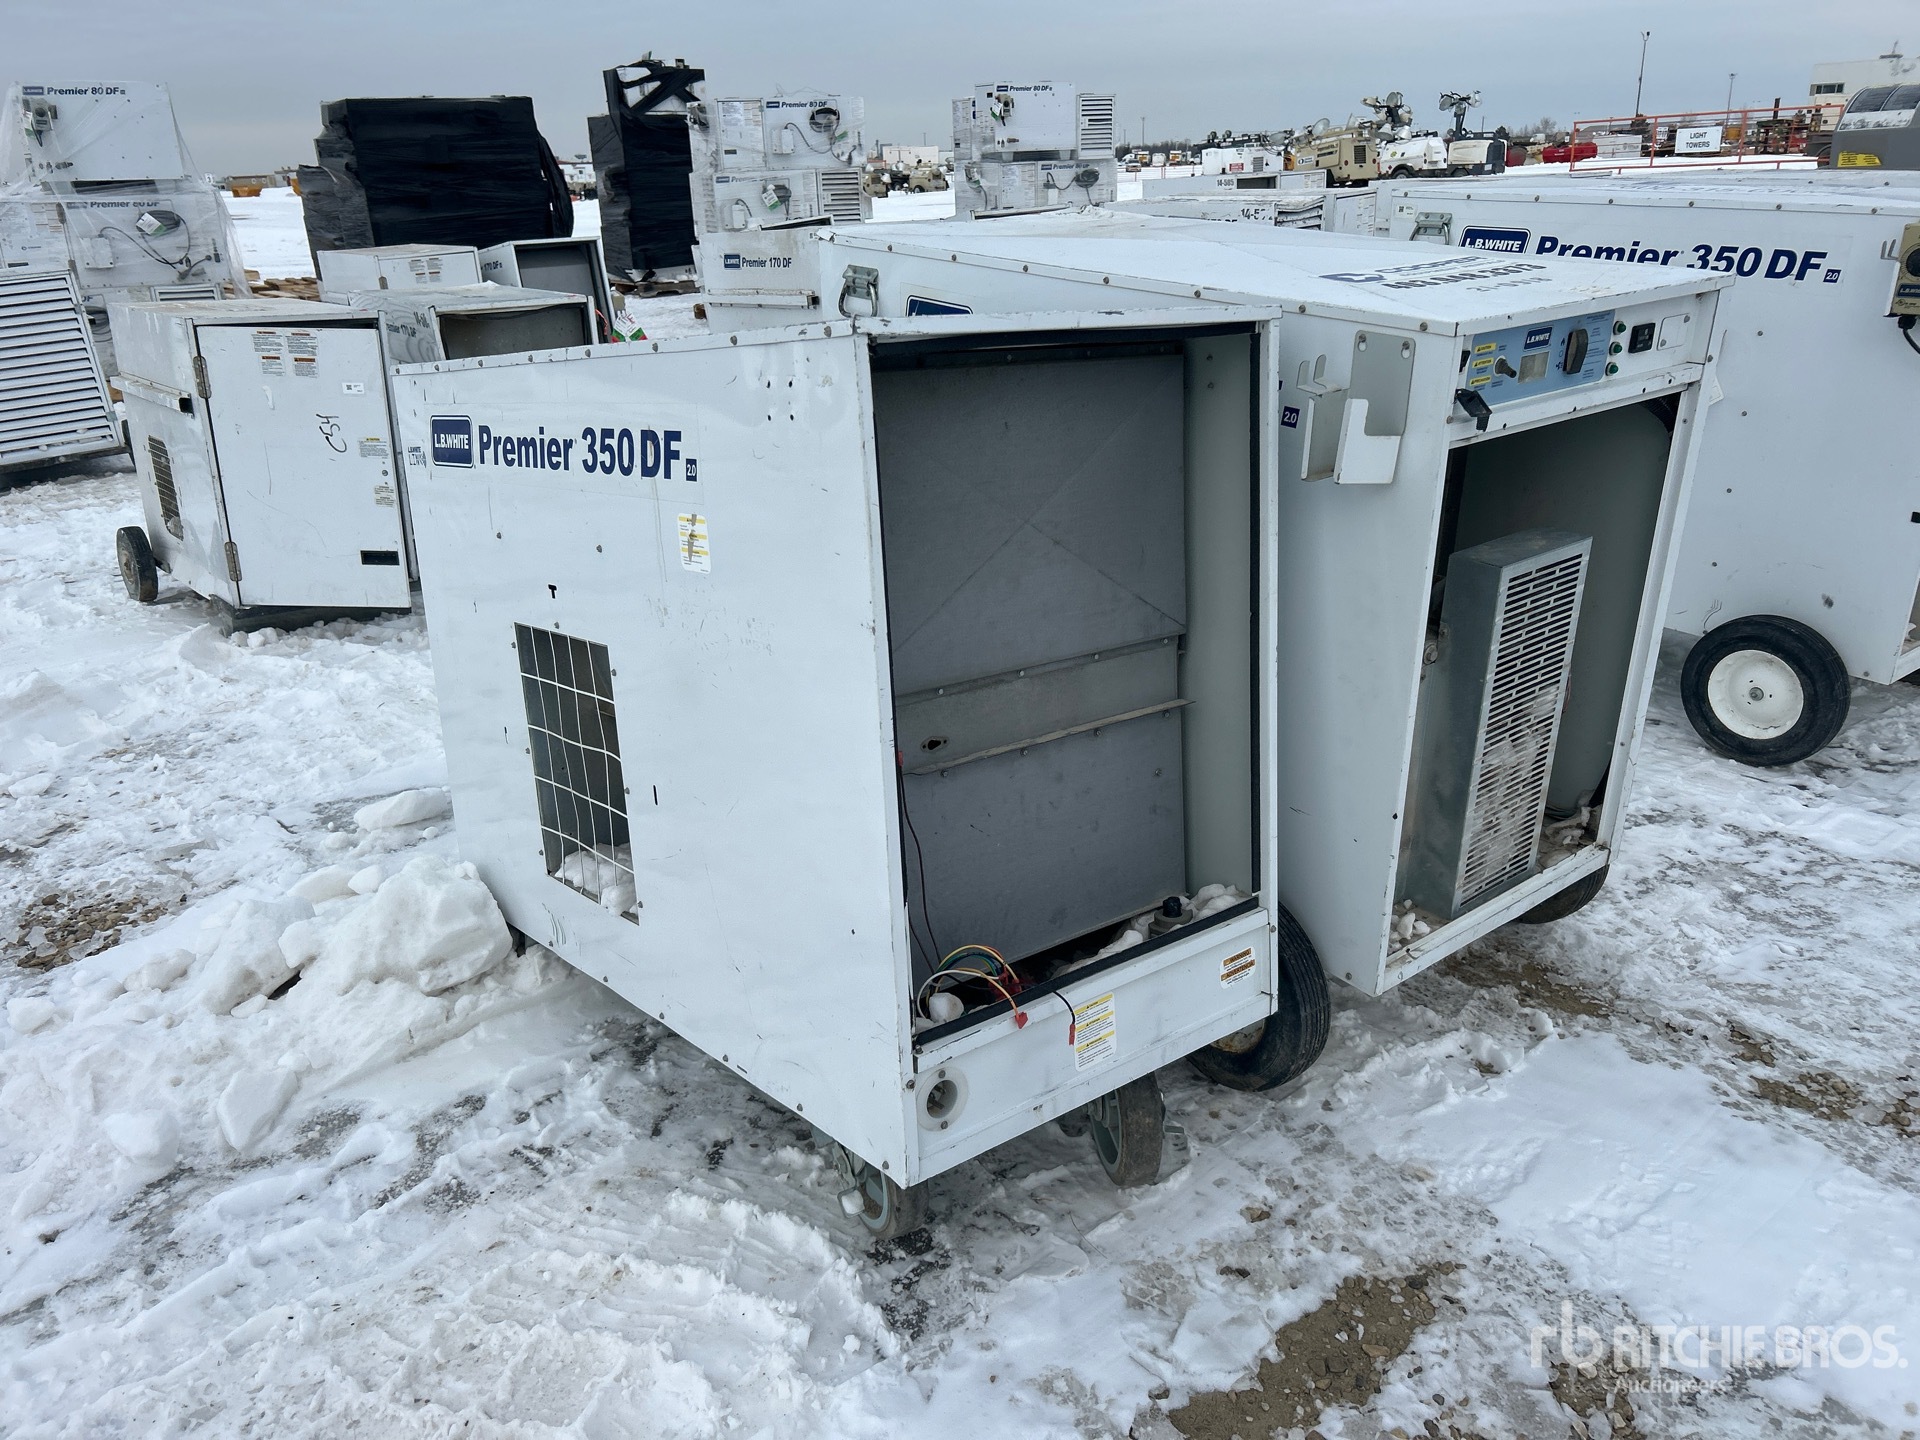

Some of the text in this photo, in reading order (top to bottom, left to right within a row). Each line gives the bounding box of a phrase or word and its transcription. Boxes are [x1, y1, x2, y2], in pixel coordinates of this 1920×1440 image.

[47, 87, 88, 95] Premier
[91, 87, 104, 95] 80
[105, 87, 119, 95] DF
[1690, 131, 1707, 139] LIGHT
[1686, 141, 1710, 149] TOWERS
[1465, 238, 1522, 251] L.B.WHITE
[741, 257, 767, 268] Premier
[769, 257, 782, 268] 170
[782, 257, 792, 268] DF
[1536, 235, 1839, 281] Premier 350 DF 2.0
[1284, 411, 1297, 424] 2.0
[434, 433, 469, 450] L.B.WHITE
[478, 425, 697, 480] Premier 350 DF 2.0
